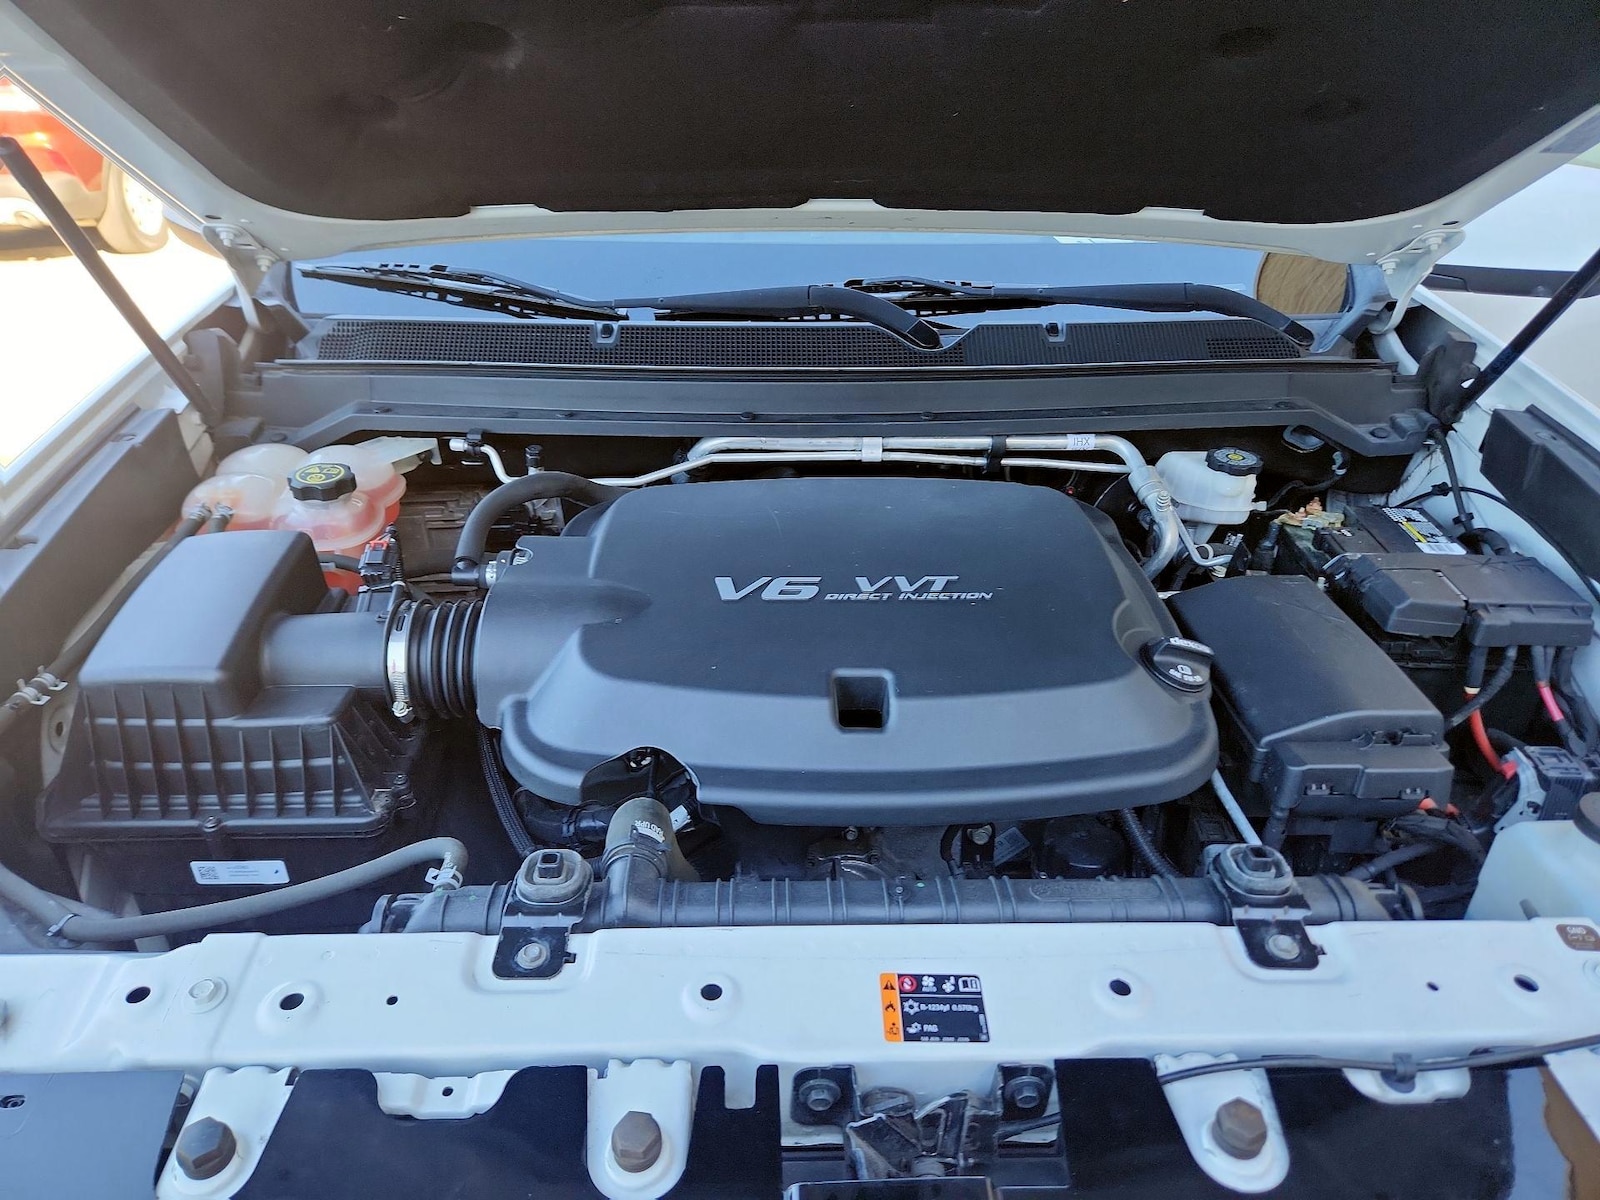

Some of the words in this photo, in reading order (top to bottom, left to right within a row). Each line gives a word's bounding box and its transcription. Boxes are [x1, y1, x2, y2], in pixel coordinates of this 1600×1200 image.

[714, 576, 823, 601] V6
[855, 575, 960, 592] VVT
[824, 592, 893, 601] DIRECT
[898, 592, 995, 601] INJECTION
